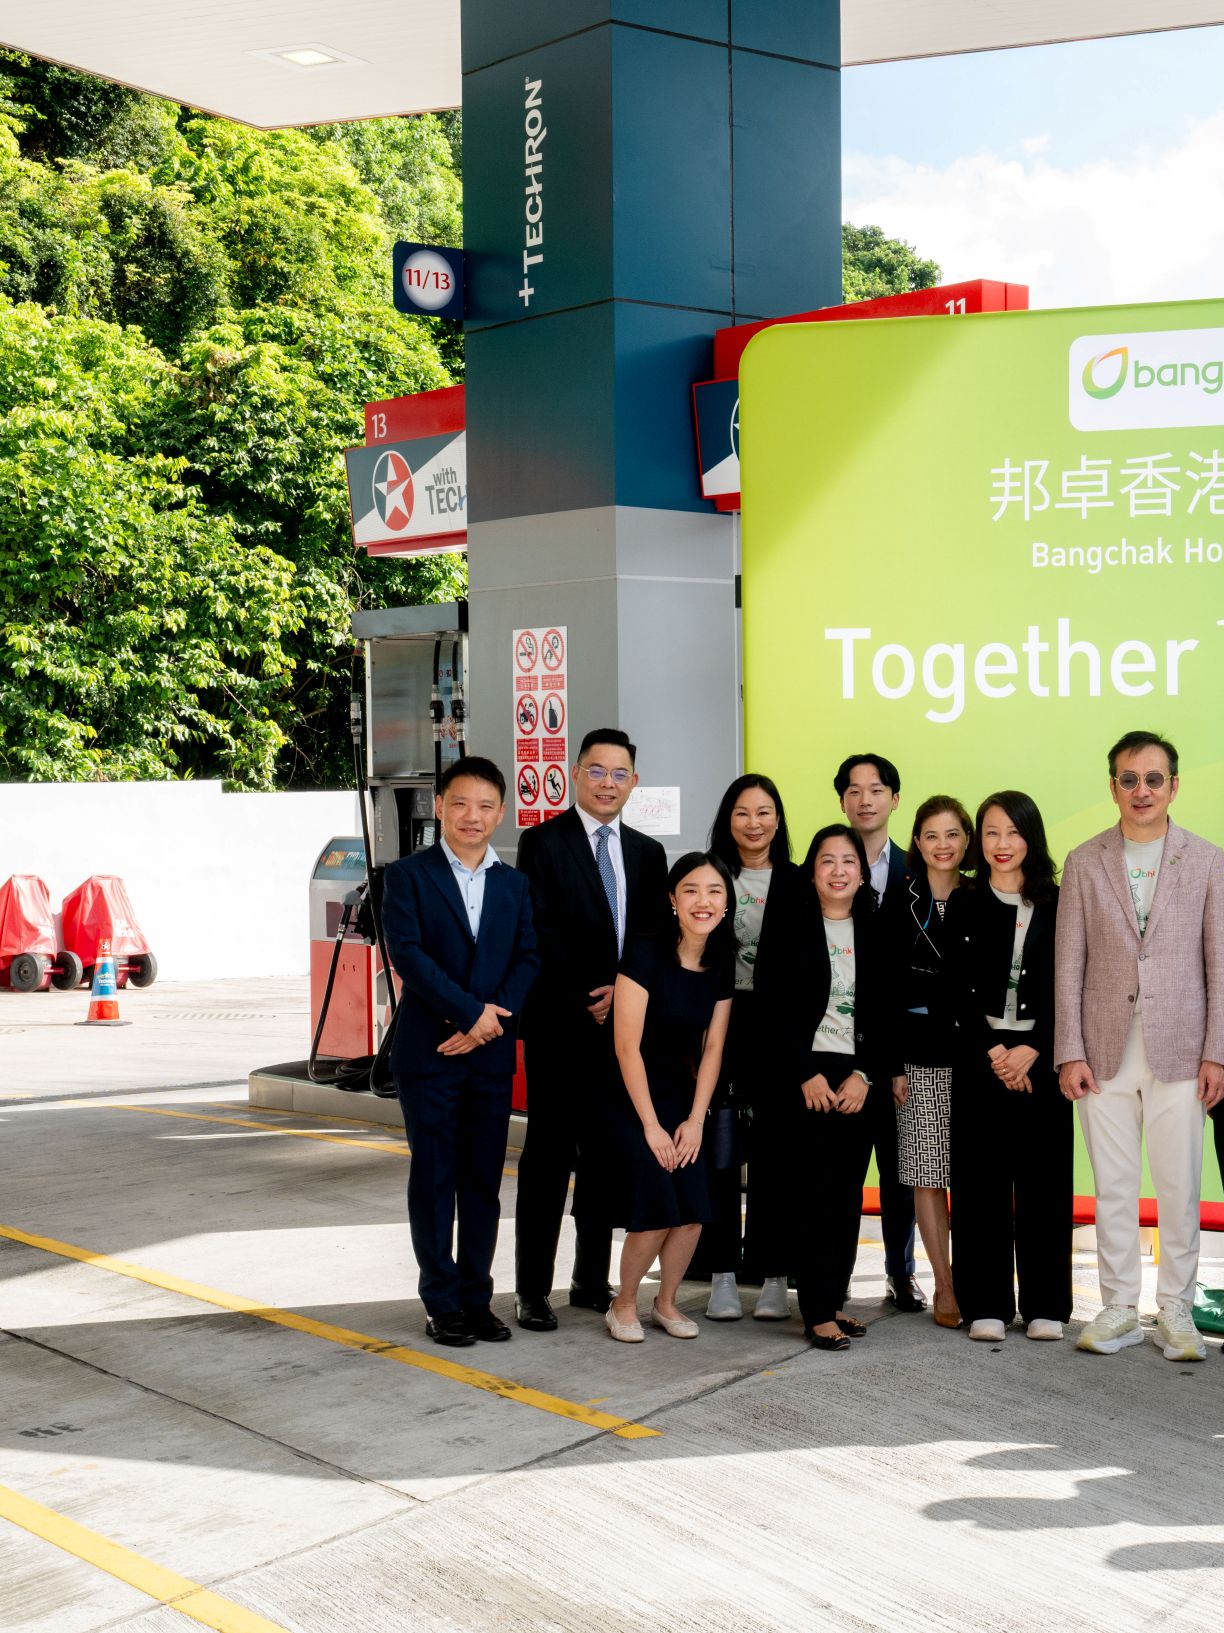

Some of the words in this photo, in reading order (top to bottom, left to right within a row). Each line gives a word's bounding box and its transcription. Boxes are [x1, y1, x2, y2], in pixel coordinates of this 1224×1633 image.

[405, 268, 451, 290] 11/13
[945, 297, 967, 316] 11
[371, 412, 388, 439] 13
[432, 466, 458, 486] with
[1032, 536, 1173, 574] Bangchak
[824, 617, 1200, 724] Together
[750, 896, 766, 904] bhk
[836, 946, 853, 956] bhk
[816, 1023, 839, 1036] ether
